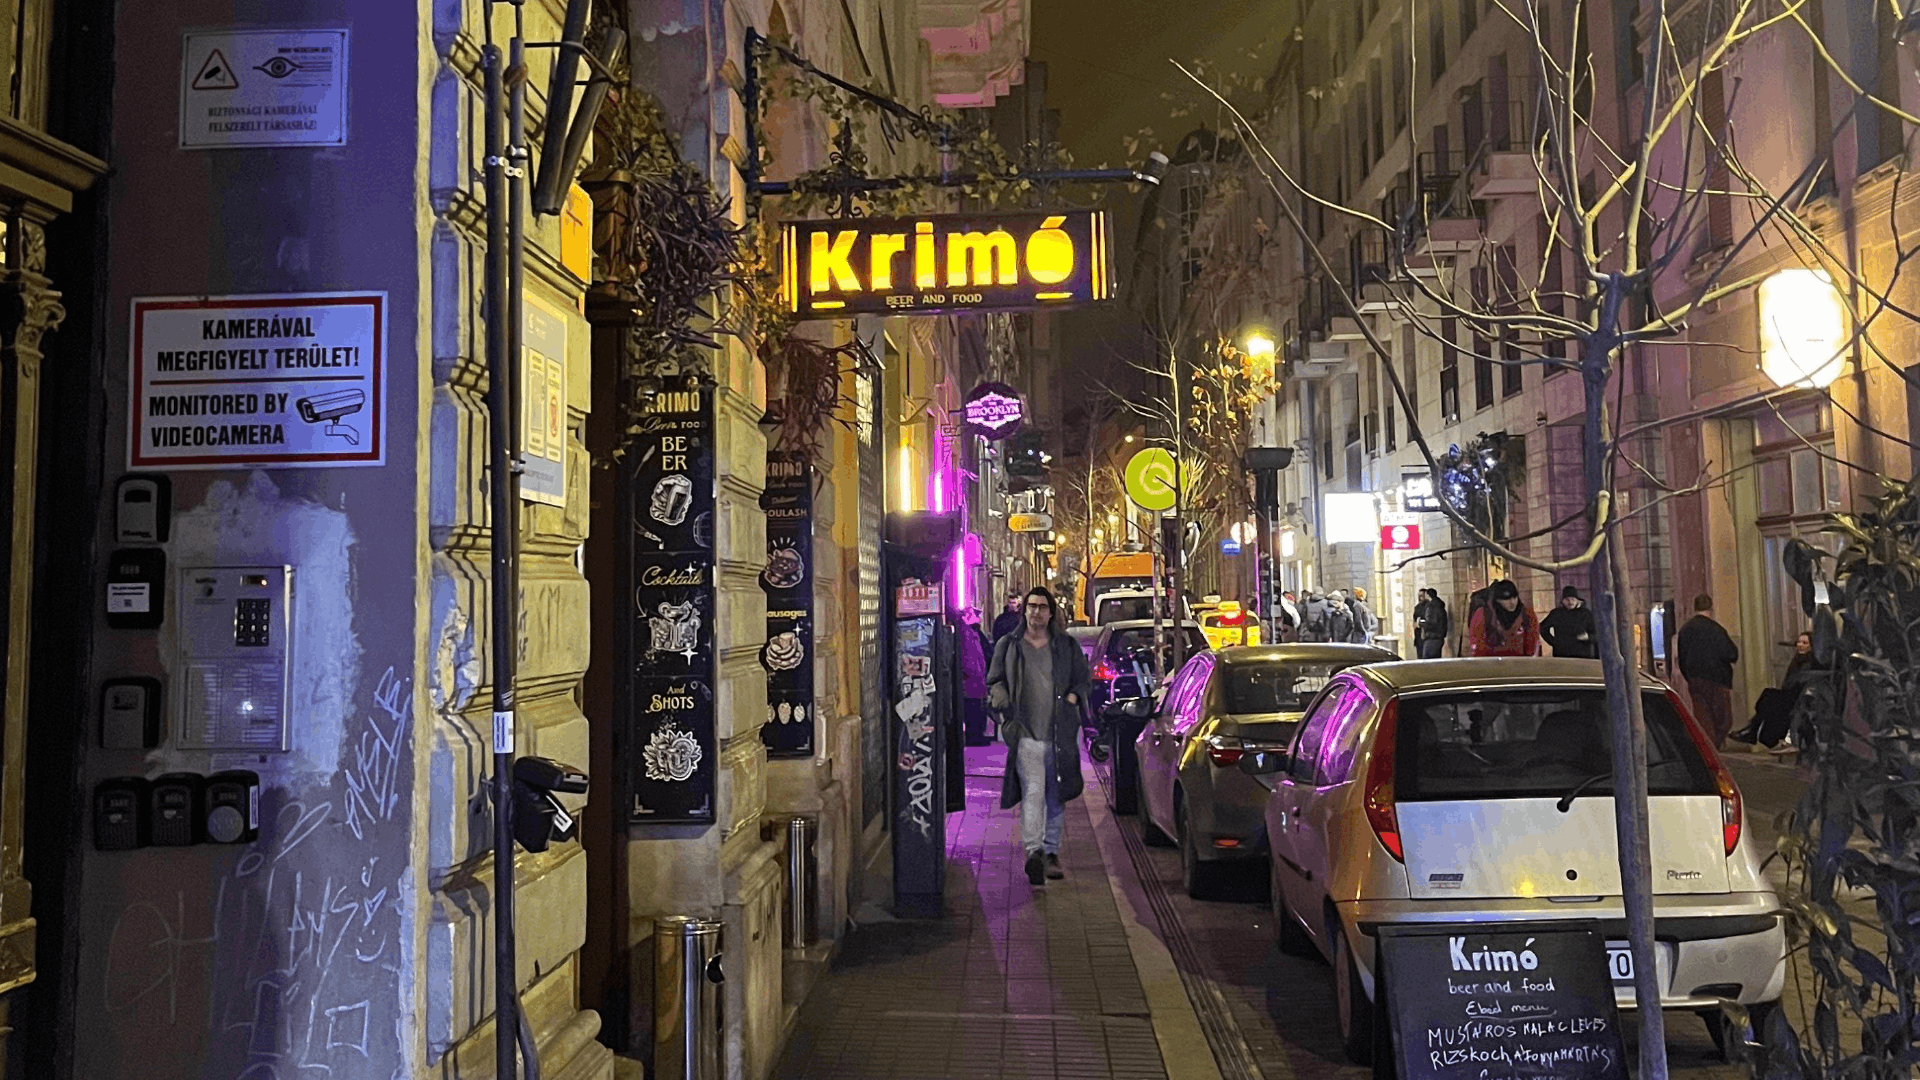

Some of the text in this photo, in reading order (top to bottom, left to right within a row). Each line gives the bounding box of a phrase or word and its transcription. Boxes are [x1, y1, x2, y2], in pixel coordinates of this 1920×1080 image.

[810, 216, 1074, 294] Krimó
[886, 293, 982, 305] BEER AND FOOD
[203, 314, 315, 339] KAMERÁVAL
[157, 344, 359, 371] MEGFIGYELT TERÜLET!
[149, 393, 288, 416] MONITORED BY
[967, 403, 1020, 418] BROOKLYN
[151, 424, 285, 447] VIDEOCAMERA
[662, 436, 687, 452] BE
[662, 455, 688, 471] ER
[767, 508, 807, 518] OULASH
[642, 565, 703, 587] Cocktails
[767, 610, 807, 620] ausages
[1449, 936, 1538, 972] Krimó
[1448, 977, 1555, 994] beer and food
